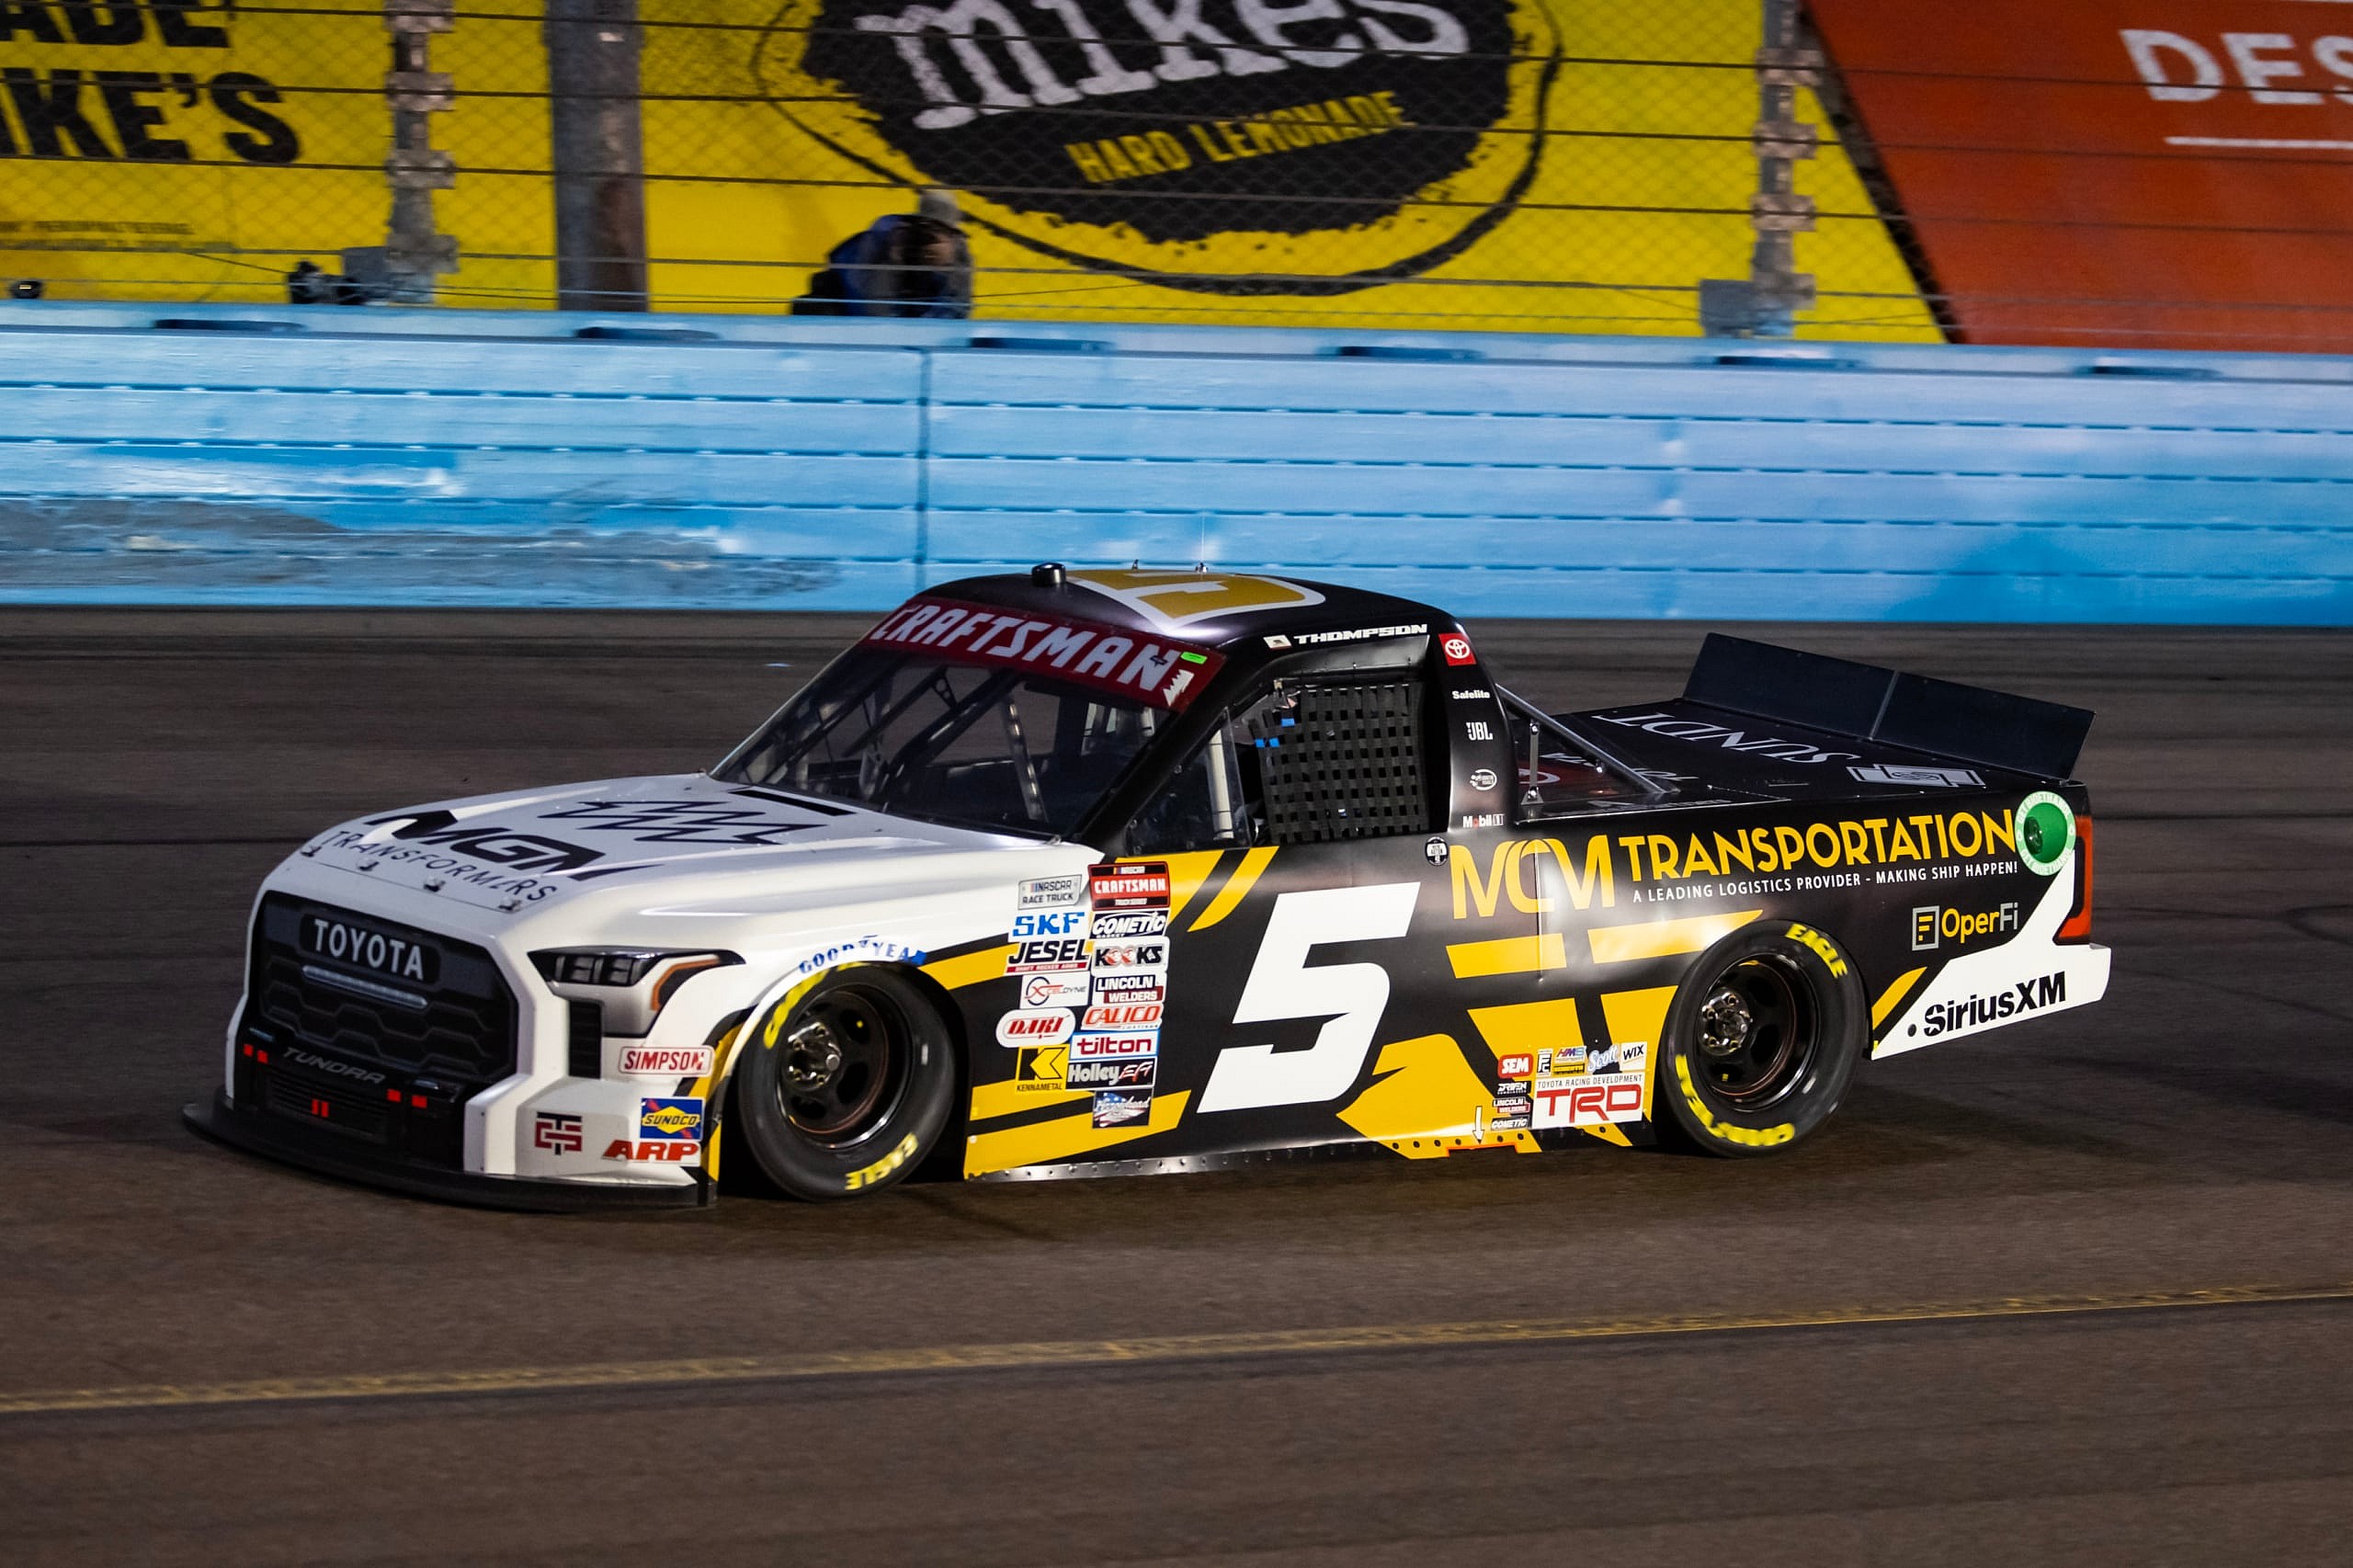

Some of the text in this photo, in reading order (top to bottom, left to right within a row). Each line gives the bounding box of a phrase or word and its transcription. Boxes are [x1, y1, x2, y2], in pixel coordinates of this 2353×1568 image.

[1064, 90, 1406, 184] HARD LEMONADE
[1293, 623, 1427, 645] THOMPSON
[870, 604, 1182, 692] CRAFTSMAN
[1452, 689, 1490, 699] Safelite
[1466, 722, 1494, 741] JBL
[1463, 814, 1492, 828] Mobil
[1449, 809, 2017, 920] MCM TRANSPORTATION
[1094, 878, 1166, 894] CRAFTSMAN
[1632, 889, 1643, 903] A
[1648, 883, 1713, 903] LEADING
[1719, 878, 1792, 897] LOGISTICS
[1796, 873, 1861, 892] PROVIDER
[1875, 867, 1927, 884] MAKING
[1931, 864, 1961, 881] SHIP
[1965, 860, 2018, 878] HAPPEN!
[1022, 892, 1074, 903] RACE TRUCK
[1012, 912, 1086, 937] SKF
[1092, 912, 1166, 936] COMETIC
[1941, 902, 2018, 944] OperFi
[314, 918, 424, 981] TOYOTA
[1008, 939, 1090, 964] JESEL
[1095, 945, 1163, 968] KOOKS
[1097, 976, 1154, 991] LINCOLN
[1108, 991, 1158, 1003] WELDERS
[1196, 881, 1421, 1114] 5
[1923, 971, 2066, 1037] SiriusXM
[1086, 1006, 1161, 1025] CALICO
[1077, 1037, 1152, 1055] tilton
[1623, 1044, 1644, 1061] WIX
[283, 1047, 386, 1085] TUNDRA
[624, 1051, 705, 1072] SIMPSON
[1501, 1057, 1529, 1074] SEM
[1067, 1062, 1120, 1085] Holley
[1538, 1074, 1643, 1089] TOYOTA RACING DEVELOPMENT
[1016, 1082, 1063, 1093] KENNAMETAL
[1536, 1084, 1643, 1123] TRD
[644, 1115, 698, 1126] SUNOCO
[602, 1139, 699, 1163] ARP
